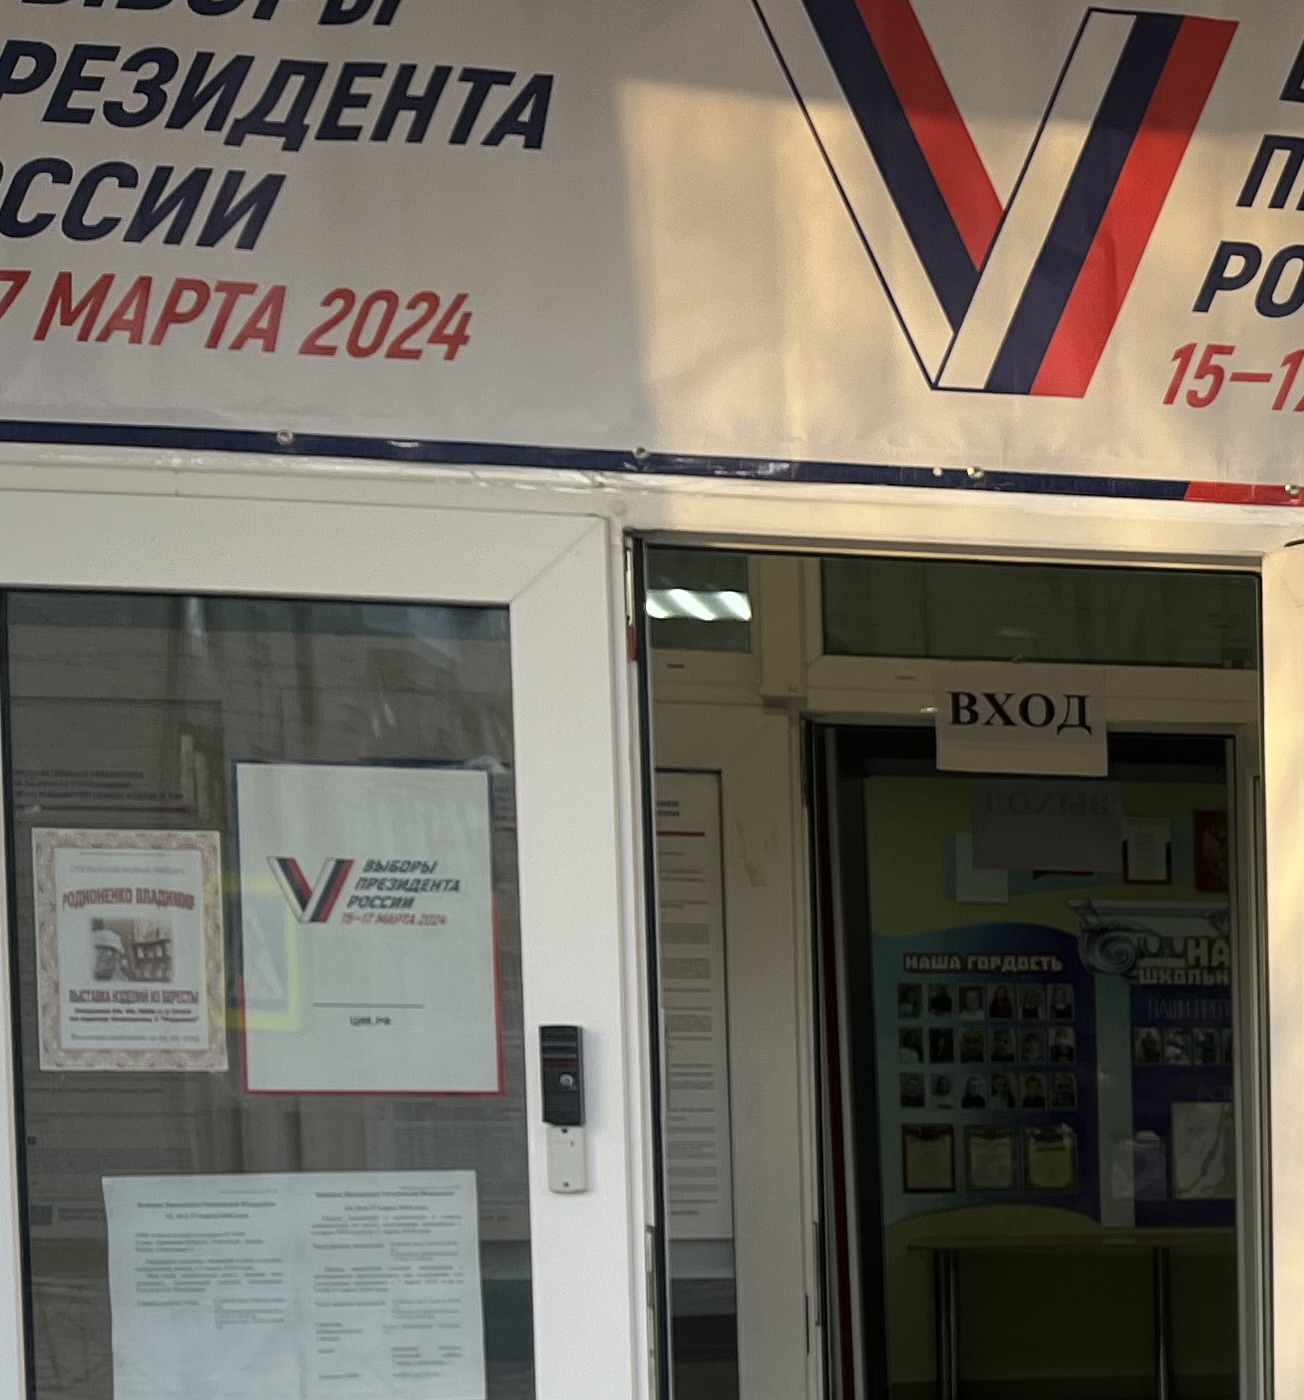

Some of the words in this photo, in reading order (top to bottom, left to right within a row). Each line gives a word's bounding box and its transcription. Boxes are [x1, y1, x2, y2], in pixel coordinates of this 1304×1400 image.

[0, 156, 287, 250] ССИИ
[32, 270, 288, 353] МАРТА
[298, 287, 472, 361] 2024
[946, 691, 1093, 736] ВХОД
[363, 858, 439, 874] ВЫБОРЫ
[354, 876, 461, 893] ПРЕЗИДЕНТА
[347, 895, 416, 909] РОССИИ
[904, 954, 961, 970] НАША
[966, 954, 1064, 973] ГОРДОСТЬ
